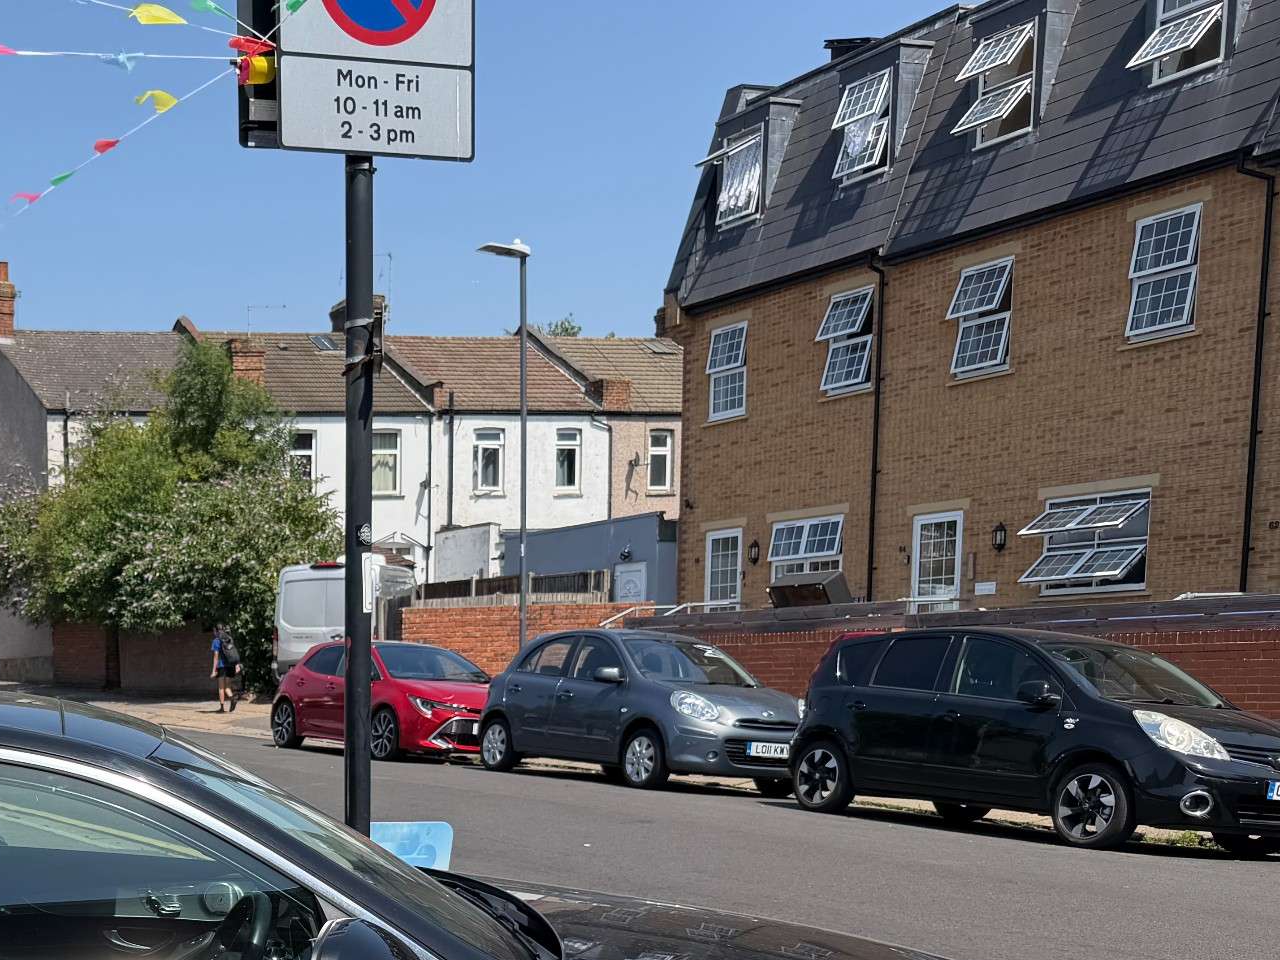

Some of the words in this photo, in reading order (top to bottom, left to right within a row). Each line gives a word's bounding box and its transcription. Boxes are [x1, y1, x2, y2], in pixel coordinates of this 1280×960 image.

[337, 69, 378, 89] Mon
[395, 73, 420, 92] Fri
[334, 96, 356, 115] 10
[394, 104, 422, 120] am
[340, 121, 353, 139] 2
[369, 123, 381, 141] 3
[386, 126, 415, 145] pm
